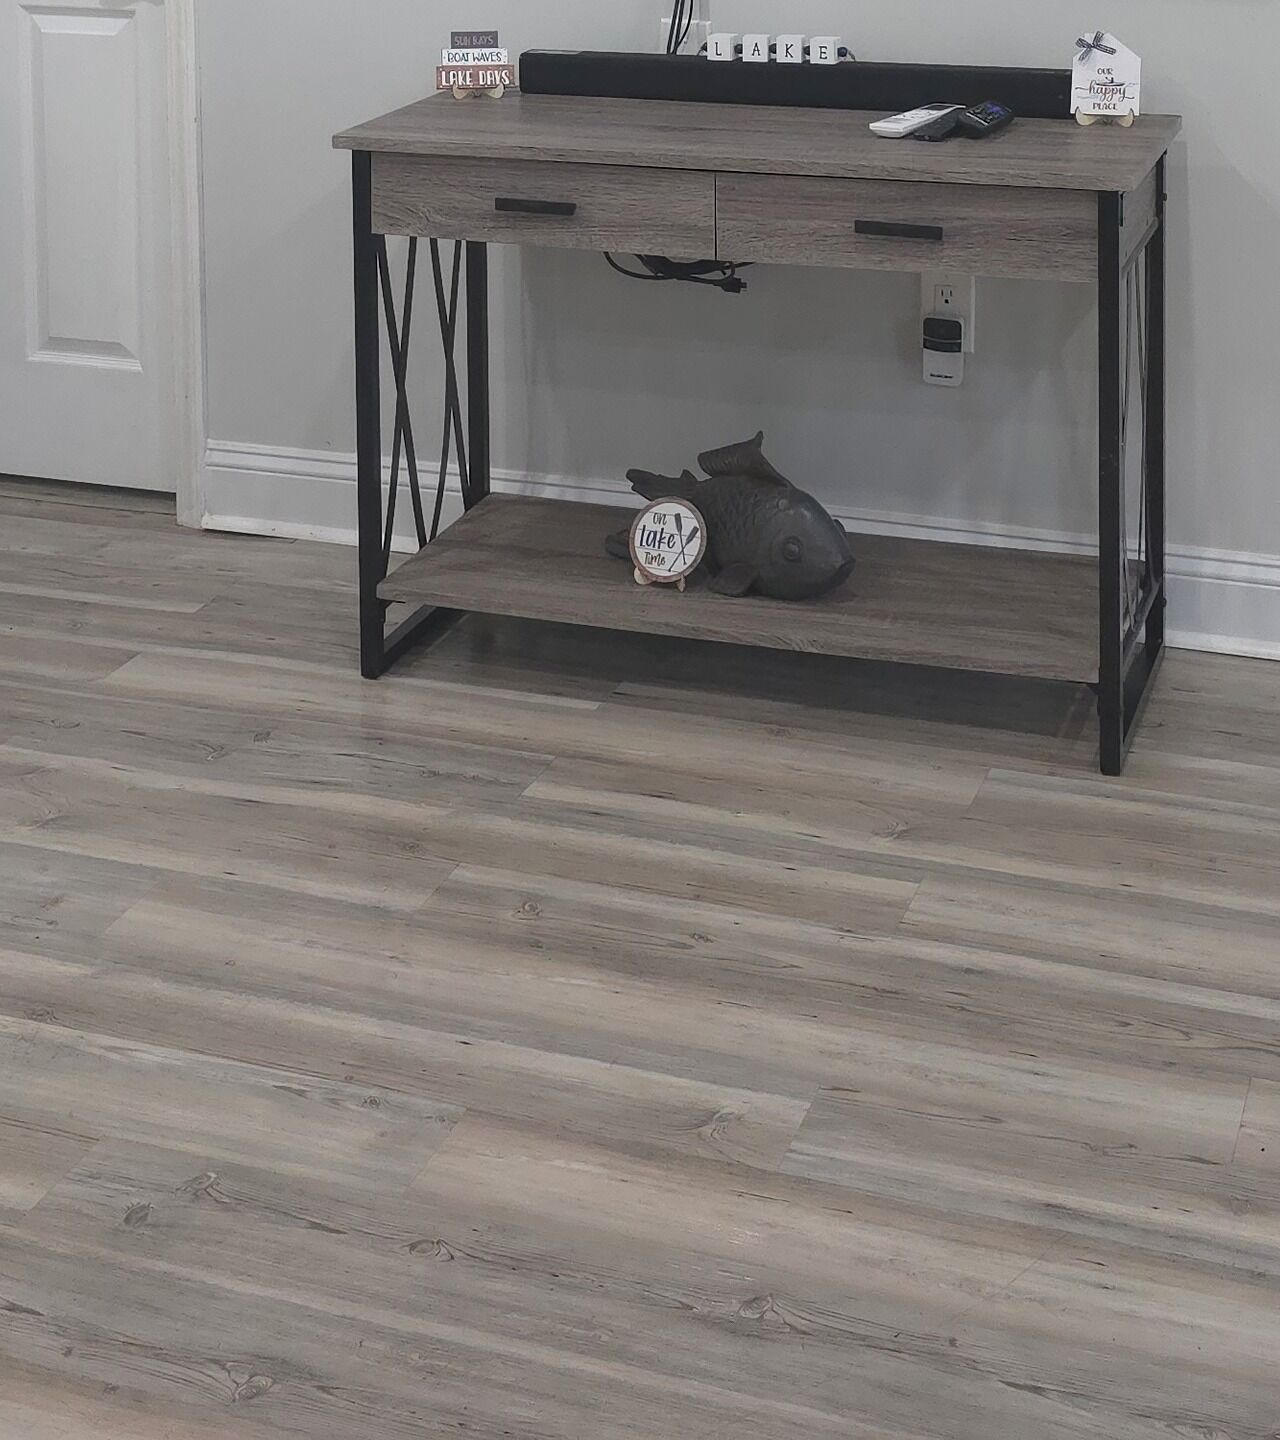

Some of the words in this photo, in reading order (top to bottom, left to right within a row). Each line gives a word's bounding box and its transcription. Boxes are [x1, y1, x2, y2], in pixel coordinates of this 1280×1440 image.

[447, 52, 470, 63] BOAT
[472, 51, 502, 63] WAVES
[1097, 67, 1114, 75] OUR
[441, 70, 473, 86] LAKE
[479, 70, 510, 86] DAYS
[1087, 79, 1127, 102] happy
[1092, 102, 1118, 110] PLACE
